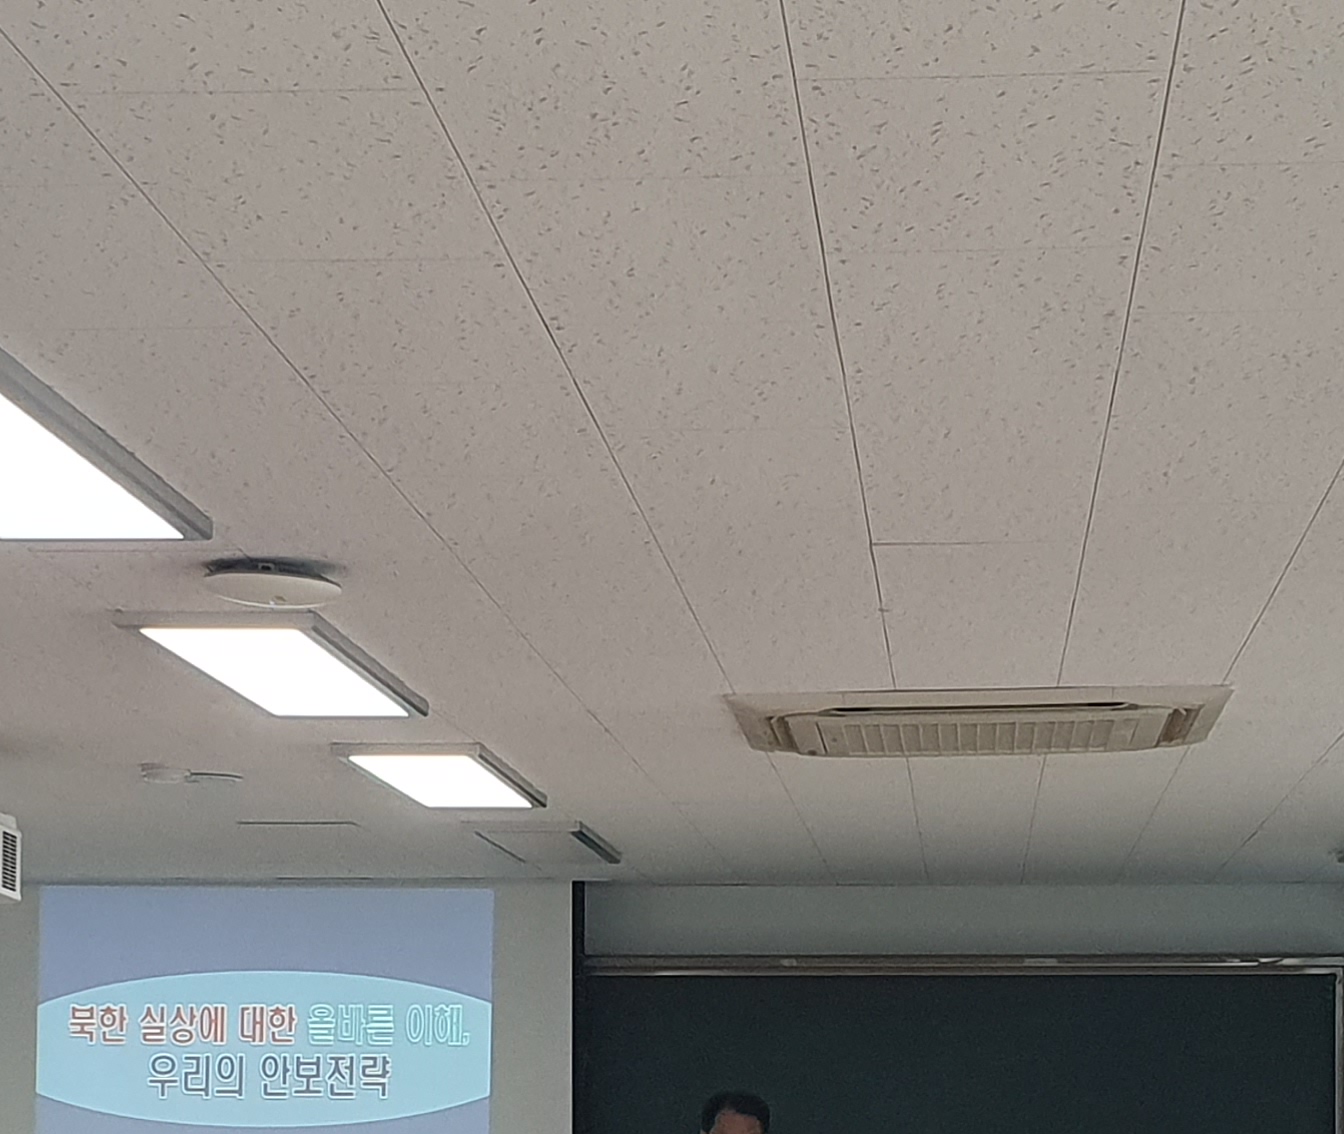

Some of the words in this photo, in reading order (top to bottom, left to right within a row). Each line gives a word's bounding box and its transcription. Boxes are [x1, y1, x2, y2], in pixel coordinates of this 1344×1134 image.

[68, 1003, 127, 1046] 북한
[138, 1003, 228, 1046] 실상에
[238, 1003, 298, 1046] 대한
[307, 1003, 395, 1046] 올바른
[406, 1003, 470, 1046] 이해,
[147, 1052, 246, 1099] 우리의
[259, 1052, 392, 1099] 안보전략
